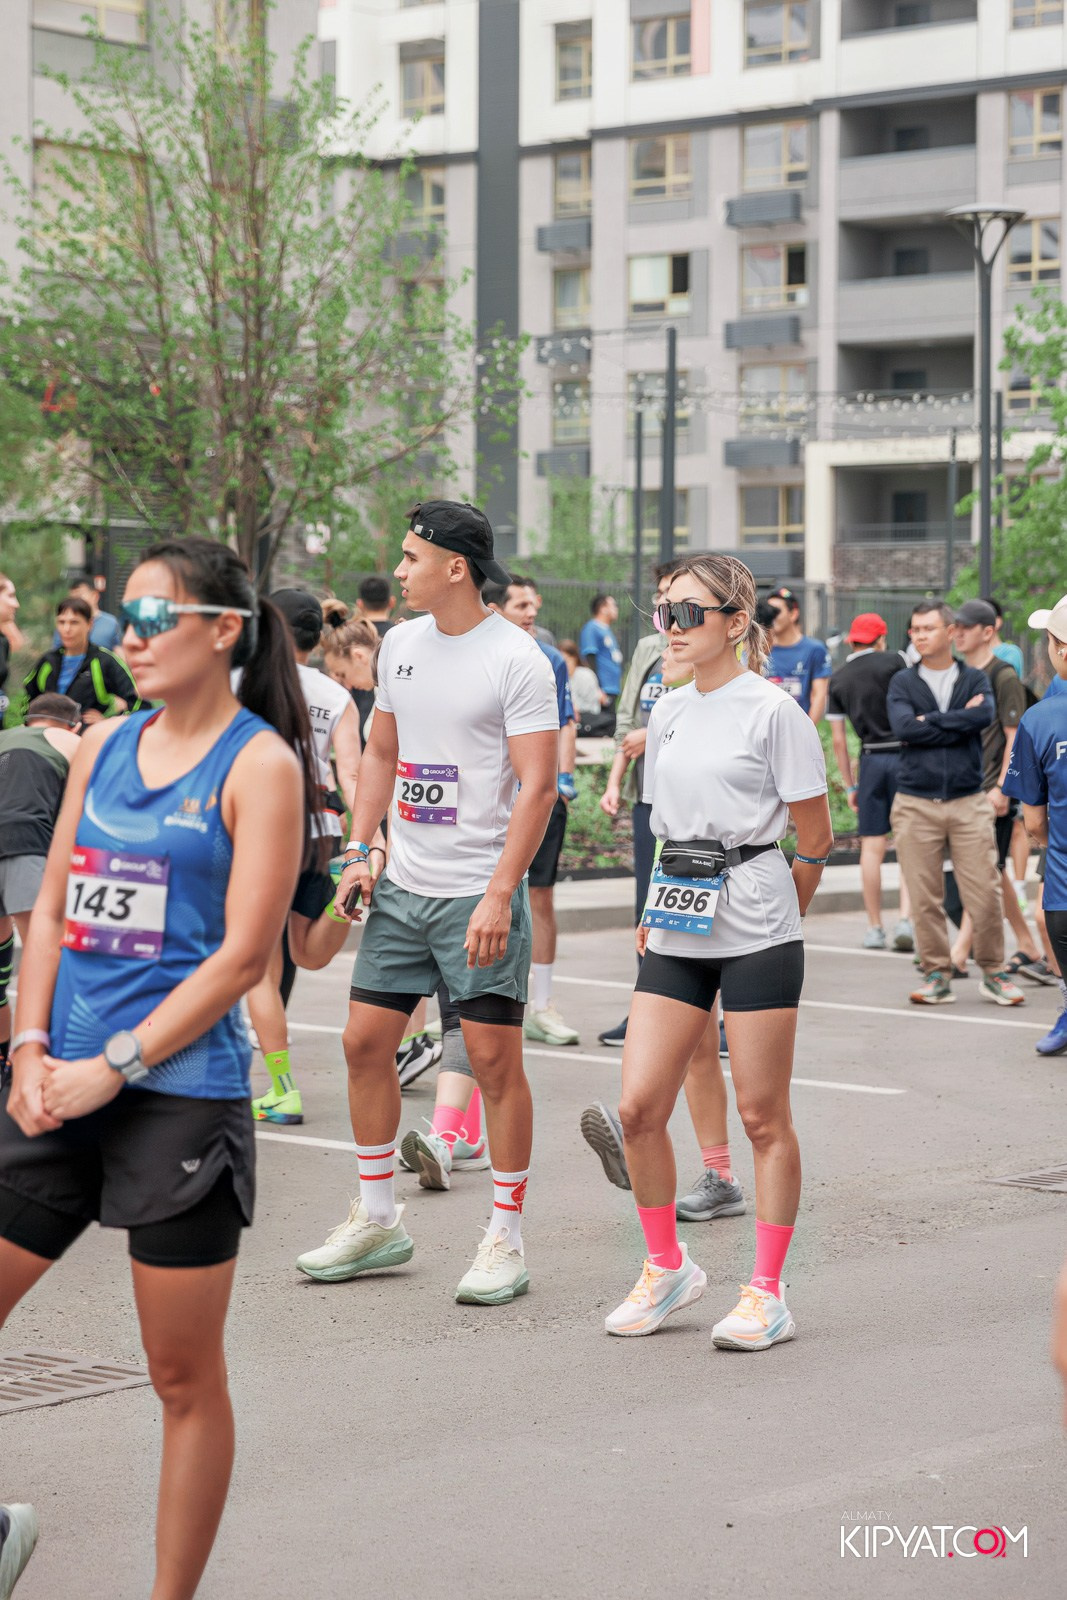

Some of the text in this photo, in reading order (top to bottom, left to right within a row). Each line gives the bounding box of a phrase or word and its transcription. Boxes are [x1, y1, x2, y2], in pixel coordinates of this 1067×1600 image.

[401, 781, 444, 805] 290
[73, 882, 137, 921] 143
[654, 886, 711, 913] 1696
